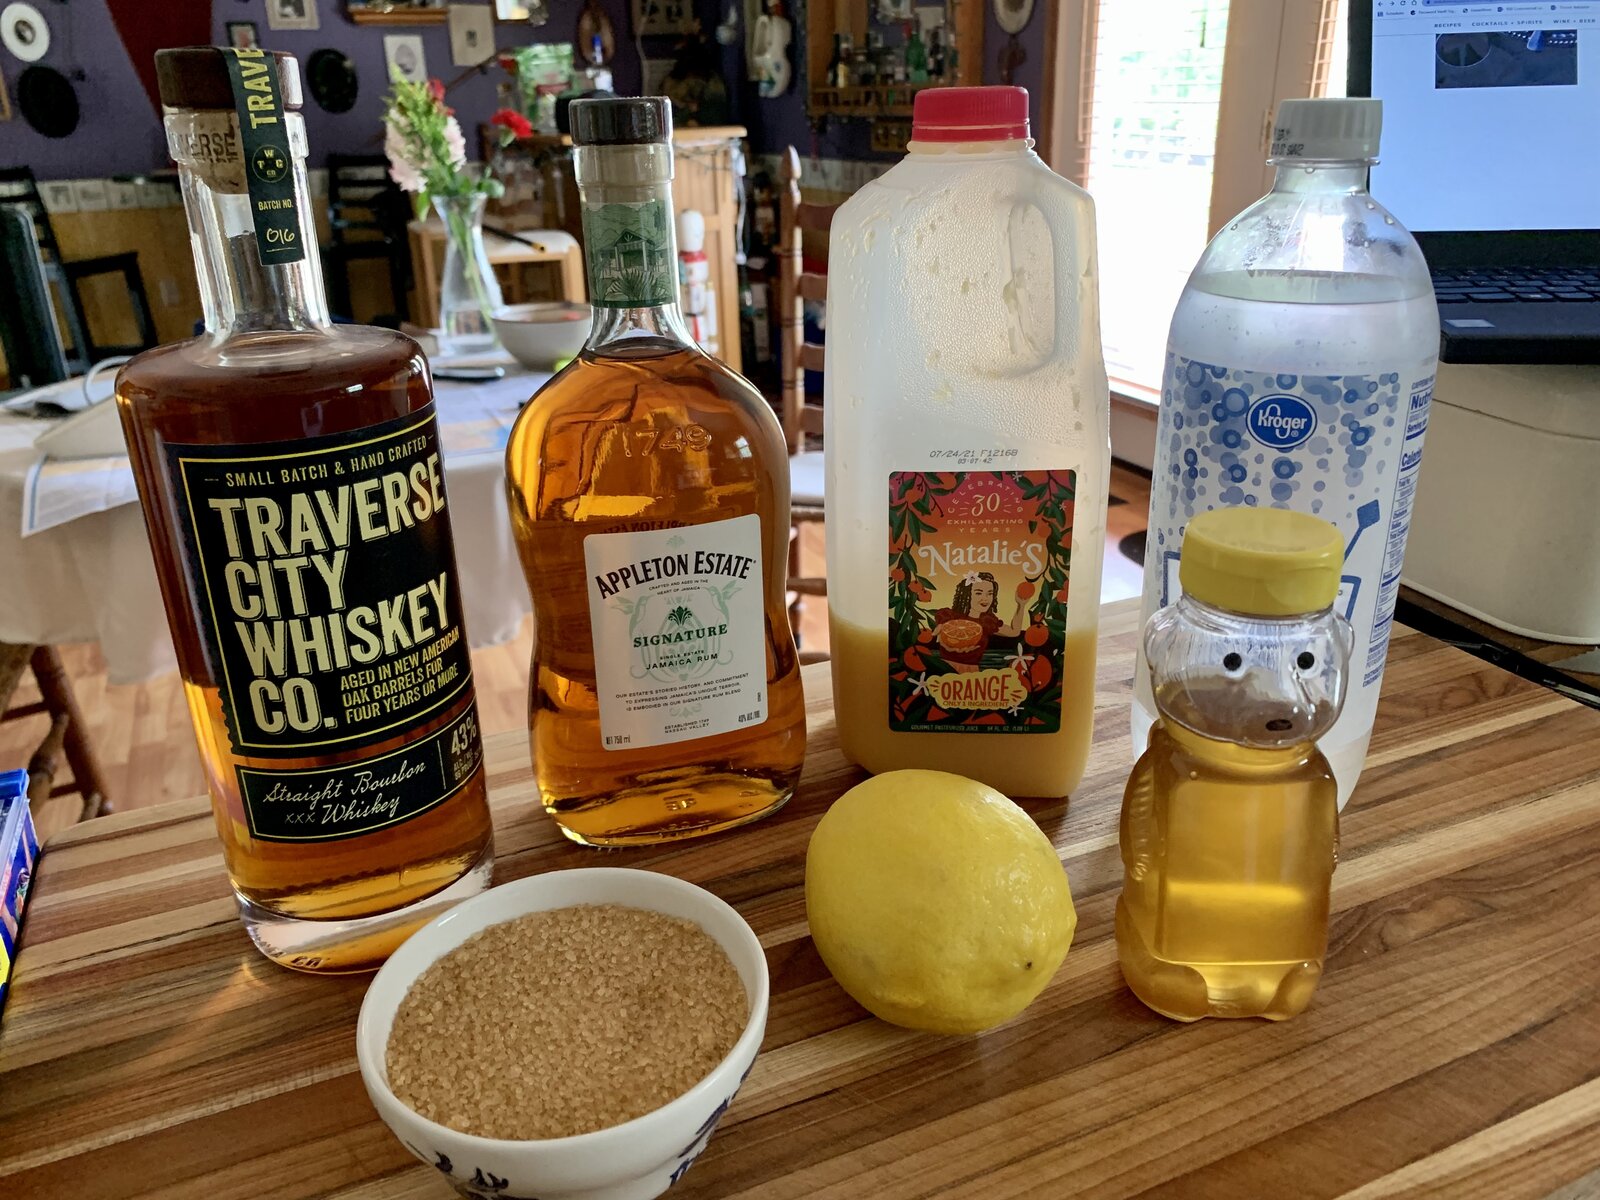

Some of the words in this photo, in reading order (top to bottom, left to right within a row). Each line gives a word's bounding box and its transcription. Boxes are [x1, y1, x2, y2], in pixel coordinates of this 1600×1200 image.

[258, 200, 281, 211] BATCH
[282, 199, 294, 209] NO.
[266, 228, 295, 245] 016
[1257, 404, 1308, 439] Kroger
[225, 472, 275, 488] SMALL
[281, 465, 328, 483] BATCH
[334, 461, 345, 475] &
[351, 451, 385, 472] HAND
[388, 435, 427, 461] CRAFTED
[929, 450, 975, 458] 07/24/21
[208, 452, 447, 559] TRAVERSE
[948, 480, 1023, 514] CELEBRATING
[971, 492, 1001, 517] 30
[224, 550, 349, 620] CITY
[595, 553, 689, 600] APPLETON
[693, 550, 753, 580] ESTATE
[648, 583, 670, 591] CRAFTED
[235, 571, 449, 678] WHISKEY
[633, 623, 728, 648] SIGNATURE
[340, 669, 375, 691] AGED
[378, 663, 392, 681] IN
[394, 651, 419, 675] NEW
[422, 625, 460, 663] AMERICAN
[645, 658, 692, 671] JAMAICA
[697, 653, 719, 663] RUM
[342, 687, 371, 708] OAK
[373, 668, 425, 700] BARRELS
[426, 657, 444, 679] FOR
[345, 702, 381, 724] FOUR
[383, 686, 421, 713] YEARS
[422, 679, 436, 697] OR
[437, 662, 459, 689] MORE
[629, 689, 654, 697] ESTATE'S
[655, 686, 678, 694] STORIED
[715, 673, 749, 684] COMMITMENT
[633, 695, 668, 704] EXPRESSING
[669, 691, 697, 699] JAMAICA'S
[697, 687, 718, 695] UNIQUE
[633, 703, 662, 711] EMBODIED
[682, 694, 711, 704] SIGNATURE
[725, 688, 741, 696] BLEND
[940, 674, 1012, 701] ORANGE
[249, 677, 337, 735] CO.
[451, 711, 477, 756] 43%
[262, 778, 344, 810] Straight
[350, 759, 427, 796] Bourbon
[321, 792, 401, 825] Whiskey
